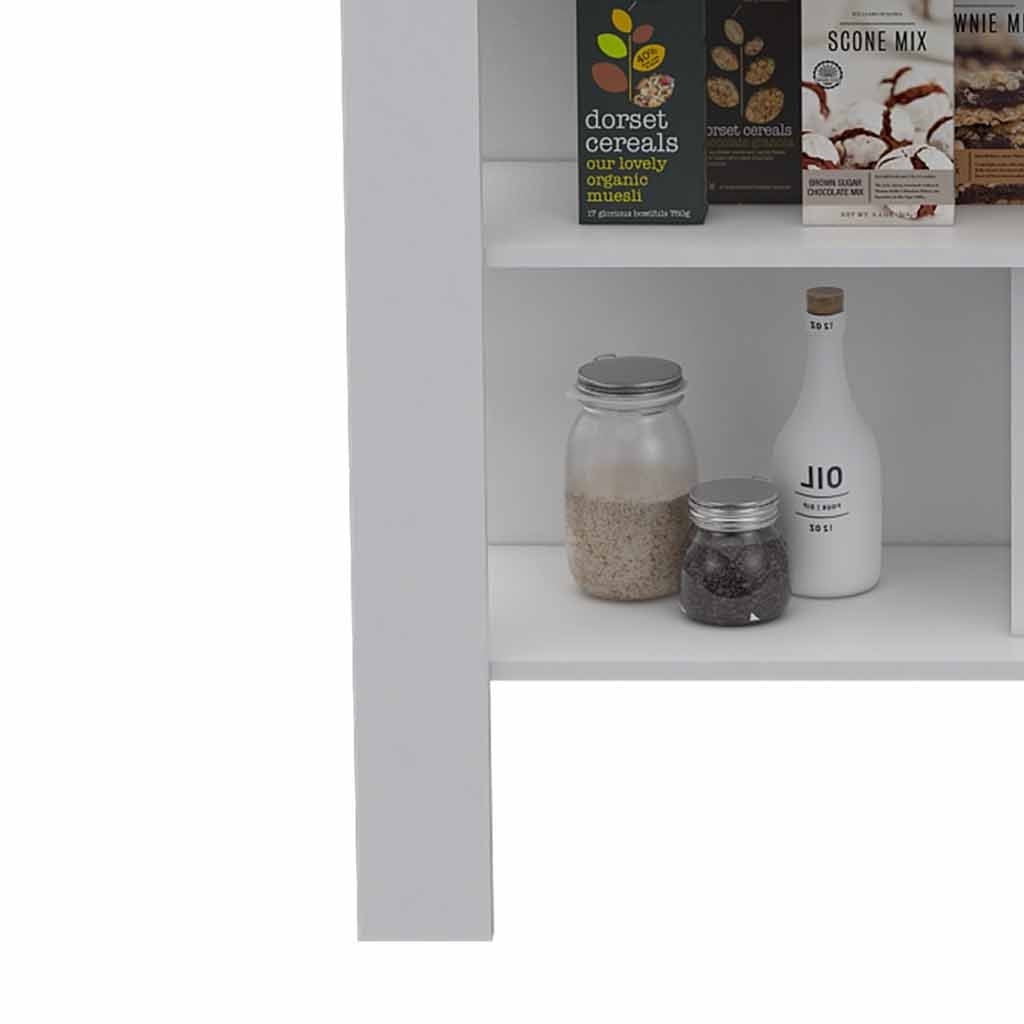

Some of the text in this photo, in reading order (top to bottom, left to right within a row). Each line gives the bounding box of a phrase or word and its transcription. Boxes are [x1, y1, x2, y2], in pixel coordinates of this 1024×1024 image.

[954, 13, 997, 34] WNIE
[827, 30, 928, 52] SCONE MIX
[585, 109, 668, 130] dorset
[743, 123, 793, 137] cereals
[585, 132, 679, 153] cereals
[586, 156, 668, 174] our lovely
[586, 174, 648, 189] organic
[808, 178, 863, 187] BROWN SUGAR
[586, 189, 643, 203] muesli
[807, 188, 848, 197] CHOCOLATE
[850, 188, 865, 197] MIX
